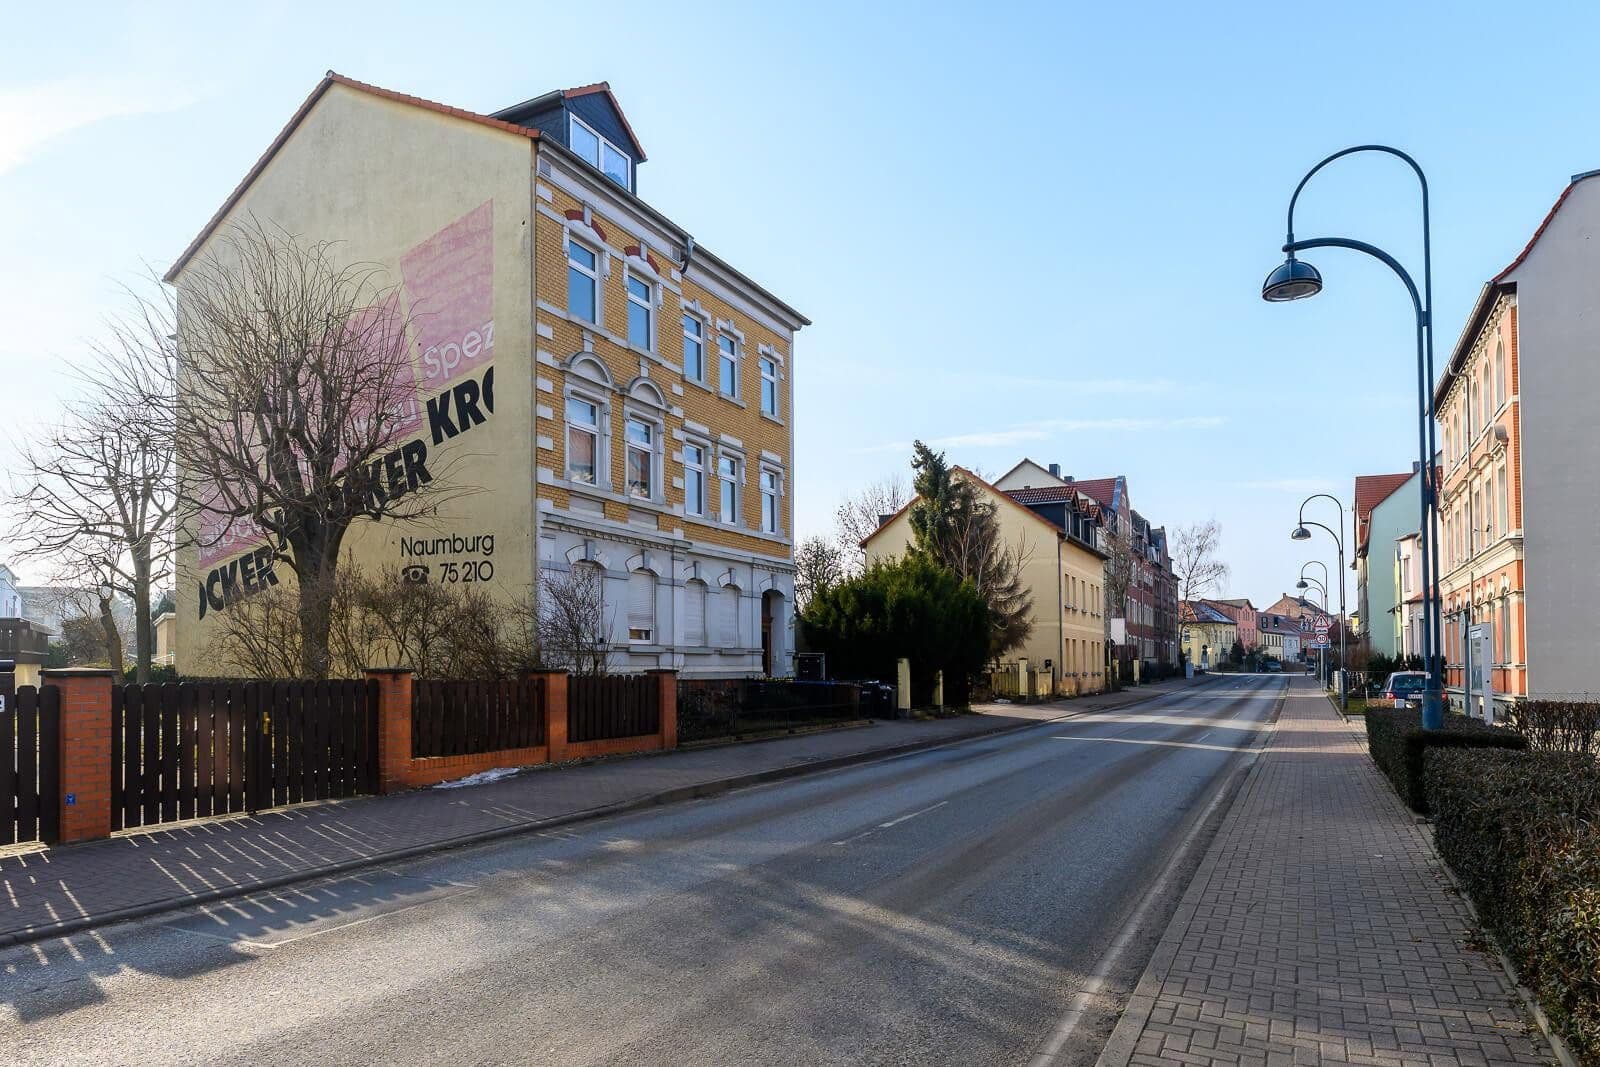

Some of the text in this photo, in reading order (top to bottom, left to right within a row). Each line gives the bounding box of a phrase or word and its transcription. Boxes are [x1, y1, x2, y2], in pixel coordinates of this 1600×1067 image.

[401, 533, 494, 557] Naumburg
[440, 560, 493, 584] 75 210
